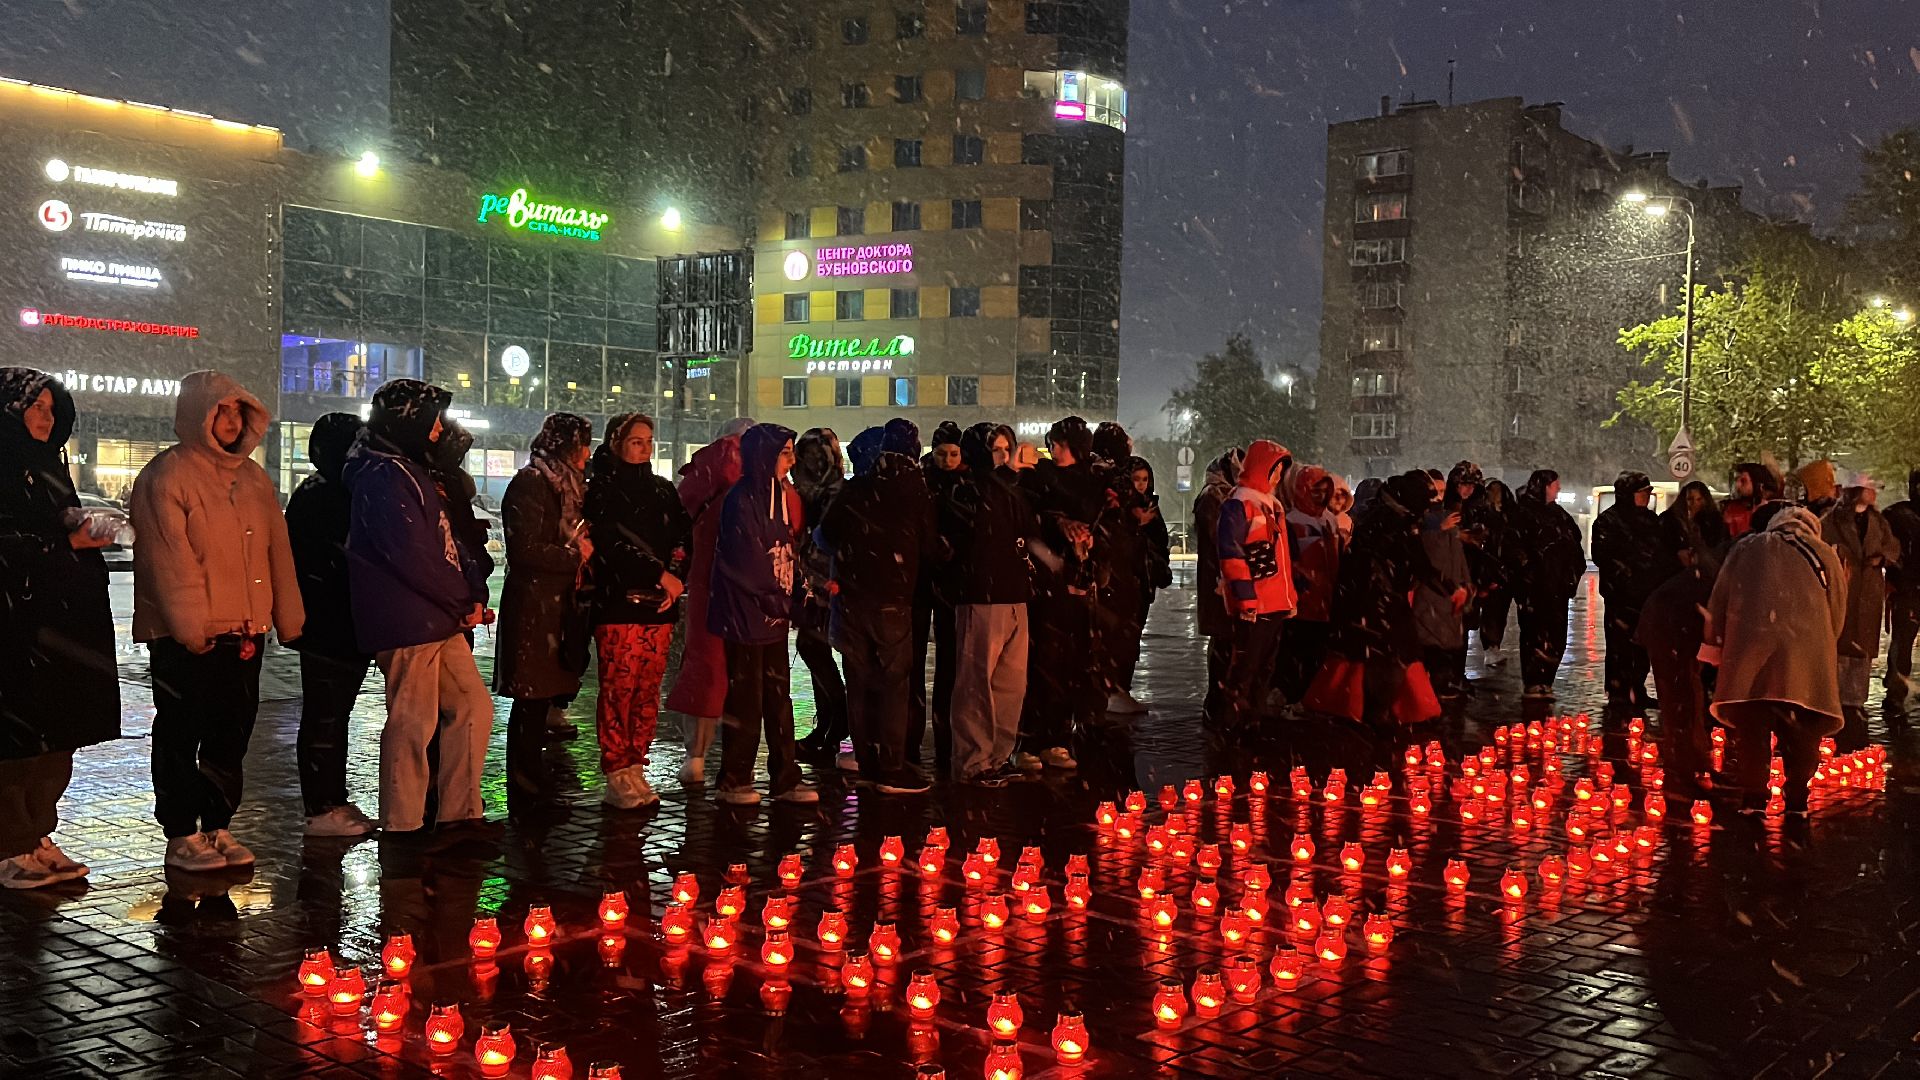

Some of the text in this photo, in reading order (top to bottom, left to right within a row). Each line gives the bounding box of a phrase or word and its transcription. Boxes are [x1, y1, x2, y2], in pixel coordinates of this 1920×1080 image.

[528, 221, 601, 241] СПА-КЛУБ
[816, 243, 912, 261] ЦЕНТР ДОКТОРА
[816, 259, 913, 276] БУБНОВСКОГО
[806, 360, 892, 374] ресторан
[92, 374, 137, 393] СТАР
[1674, 462, 1689, 472] 40
